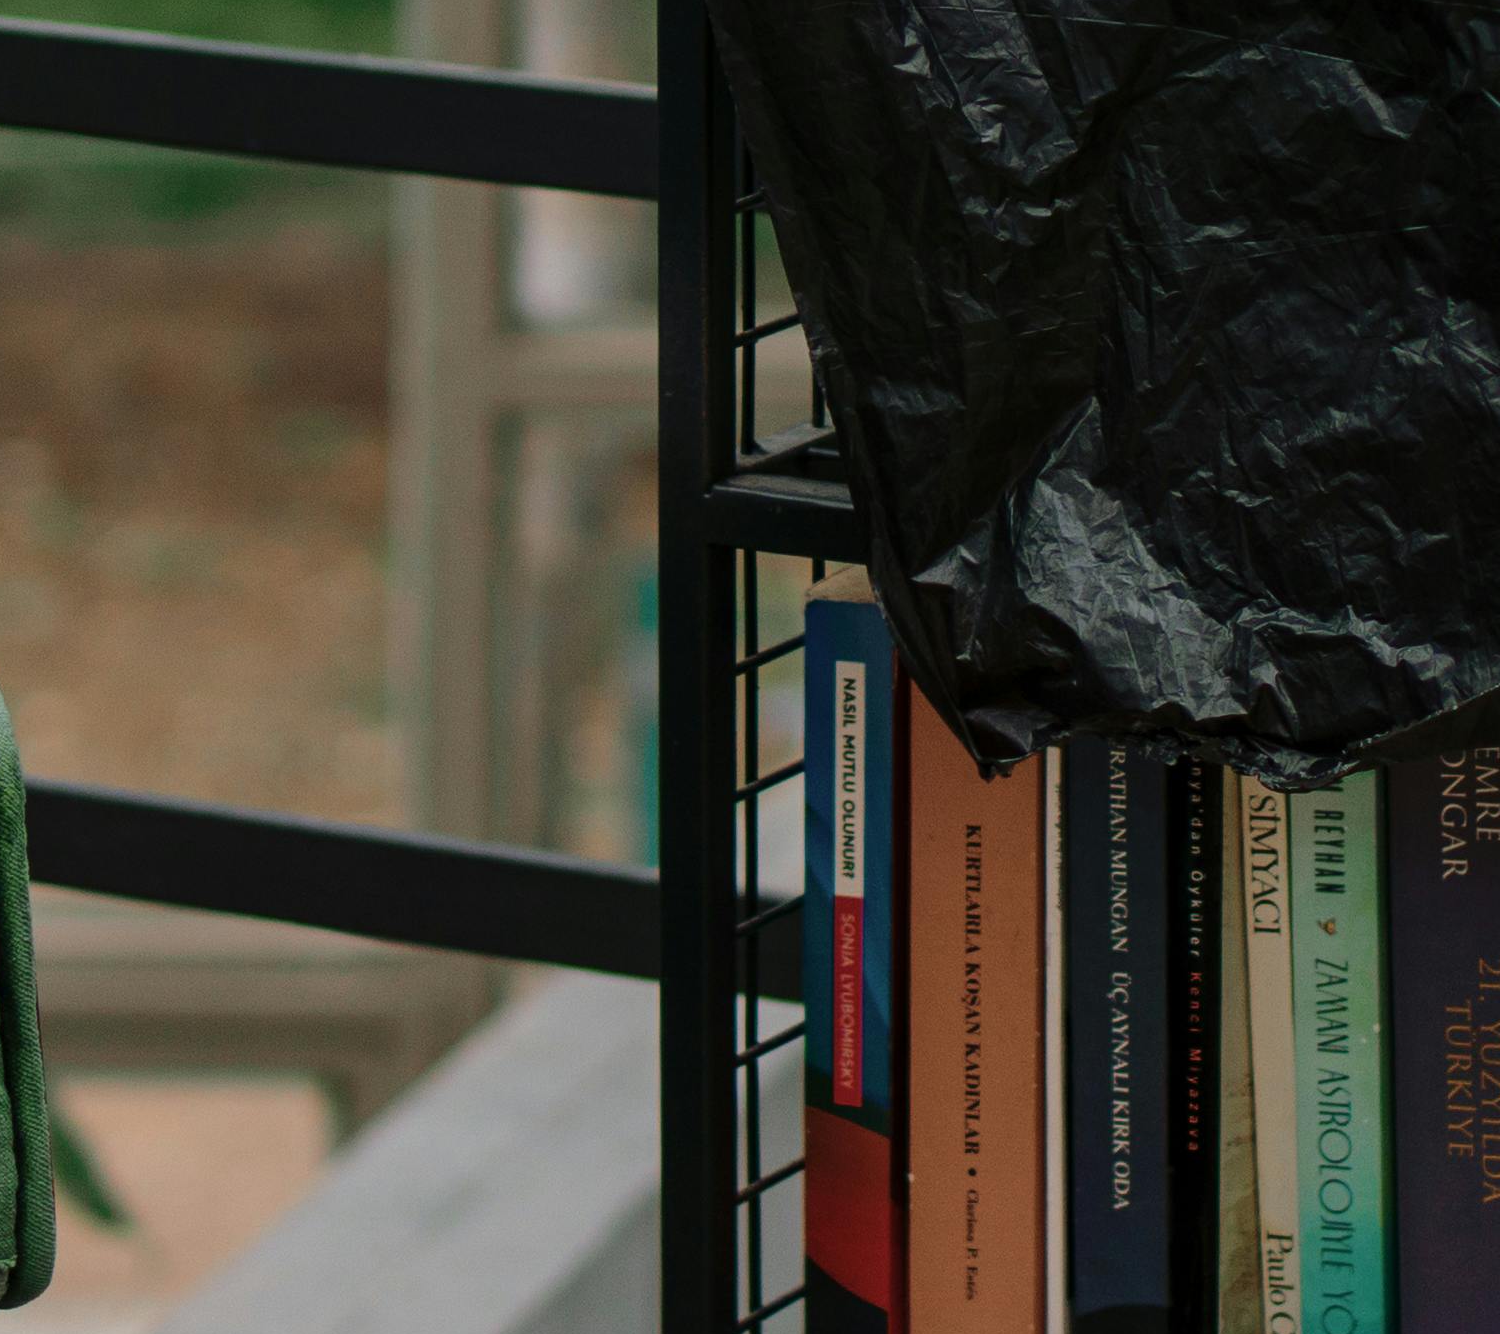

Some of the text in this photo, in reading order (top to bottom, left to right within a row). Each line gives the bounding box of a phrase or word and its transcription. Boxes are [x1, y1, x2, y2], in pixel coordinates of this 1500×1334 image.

[842, 677, 856, 880] NASIL MUTLU OLUNUR?
[964, 824, 983, 955] KURTLARLA
[1313, 808, 1346, 895] REYHAN
[1109, 849, 1130, 954] MUNGAN
[1188, 869, 1207, 959] Öyküler
[839, 973, 855, 1091] LYUBOMIRSKY
[961, 962, 983, 1035] KOŞAN
[1106, 971, 1133, 1004] ÜÇ
[1314, 958, 1350, 1055] ZAMANI
[1110, 1009, 1133, 1094] AYNALI
[1443, 998, 1476, 1159] TÜRKİYE
[964, 1042, 982, 1155] KADINLAR
[1110, 1099, 1132, 1157] KIRK
[1110, 1162, 1132, 1210] ODA
[1265, 1231, 1294, 1306] Paulo
